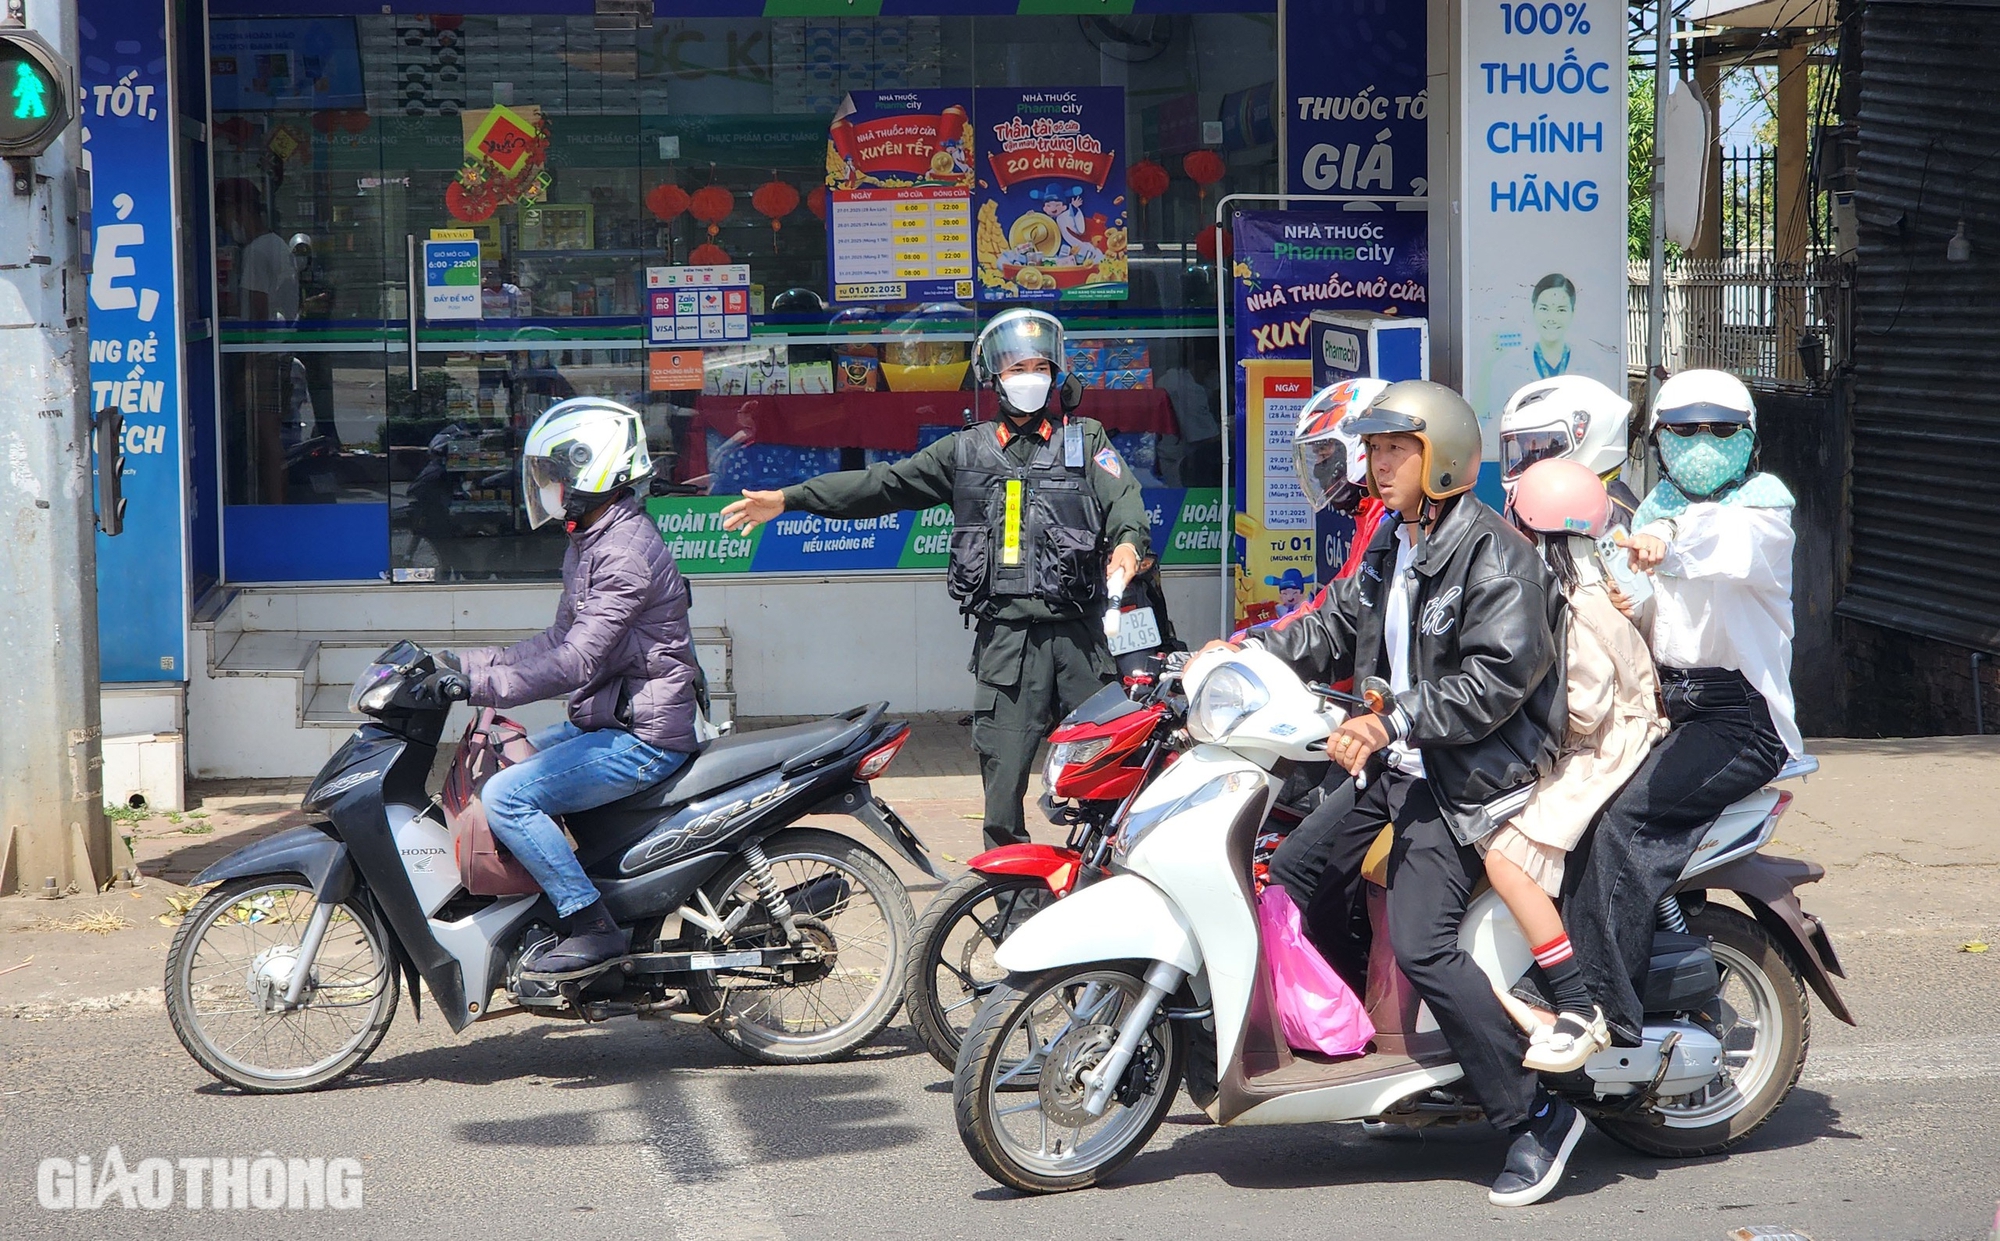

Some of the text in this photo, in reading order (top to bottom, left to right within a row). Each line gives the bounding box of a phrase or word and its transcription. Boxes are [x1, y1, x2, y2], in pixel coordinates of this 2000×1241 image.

[1500, 2, 1591, 35] 100%
[1480, 47, 1609, 94] THUỐC
[93, 69, 157, 121] TỐT,
[1022, 91, 1077, 102] NHÀ THUỐC
[1298, 84, 1388, 121] THUỐC
[1017, 102, 1083, 115] Pharmacity
[875, 124, 904, 139] THUỐC
[994, 117, 1029, 140] Thần
[1032, 118, 1053, 137] tài
[1486, 113, 1602, 153] CHÍNH
[860, 138, 933, 160] XUYÊN TẾT
[1037, 134, 1076, 153] trúng
[1077, 134, 1101, 153] lớn
[1007, 153, 1093, 174] 20 chỉ vàng
[1302, 127, 1393, 190] GIÁ
[851, 192, 872, 200] NGÀY
[1491, 174, 1599, 212] HÃNG
[1284, 221, 1384, 239] NHÀ THUỐC
[1273, 240, 1395, 265] Pharmacity
[428, 261, 447, 269] 6:00
[453, 260, 477, 268] 22:00
[678, 295, 695, 303] Zalo
[849, 285, 901, 294] 01.02.2025
[1288, 272, 1355, 303] THUỐC
[1356, 277, 1388, 298] MỞ
[1389, 281, 1426, 302] CỬA
[678, 304, 693, 312] Pay
[1252, 317, 1311, 352] XUY
[127, 331, 158, 363] RẺ
[1325, 338, 1358, 368] Pharmacity
[93, 364, 164, 413] TIỀN
[1275, 383, 1299, 392] NGÀY
[657, 507, 706, 533] HOÀN
[707, 533, 752, 564] LỆCH
[802, 533, 875, 553] NẾU KHÔNG RẺ
[1270, 537, 1311, 551] TỪ 01
[1325, 530, 1343, 568] GIÁ
[1257, 608, 1270, 620] TẾT
[1108, 627, 1157, 652] 824.95
[401, 847, 447, 856] HONDA
